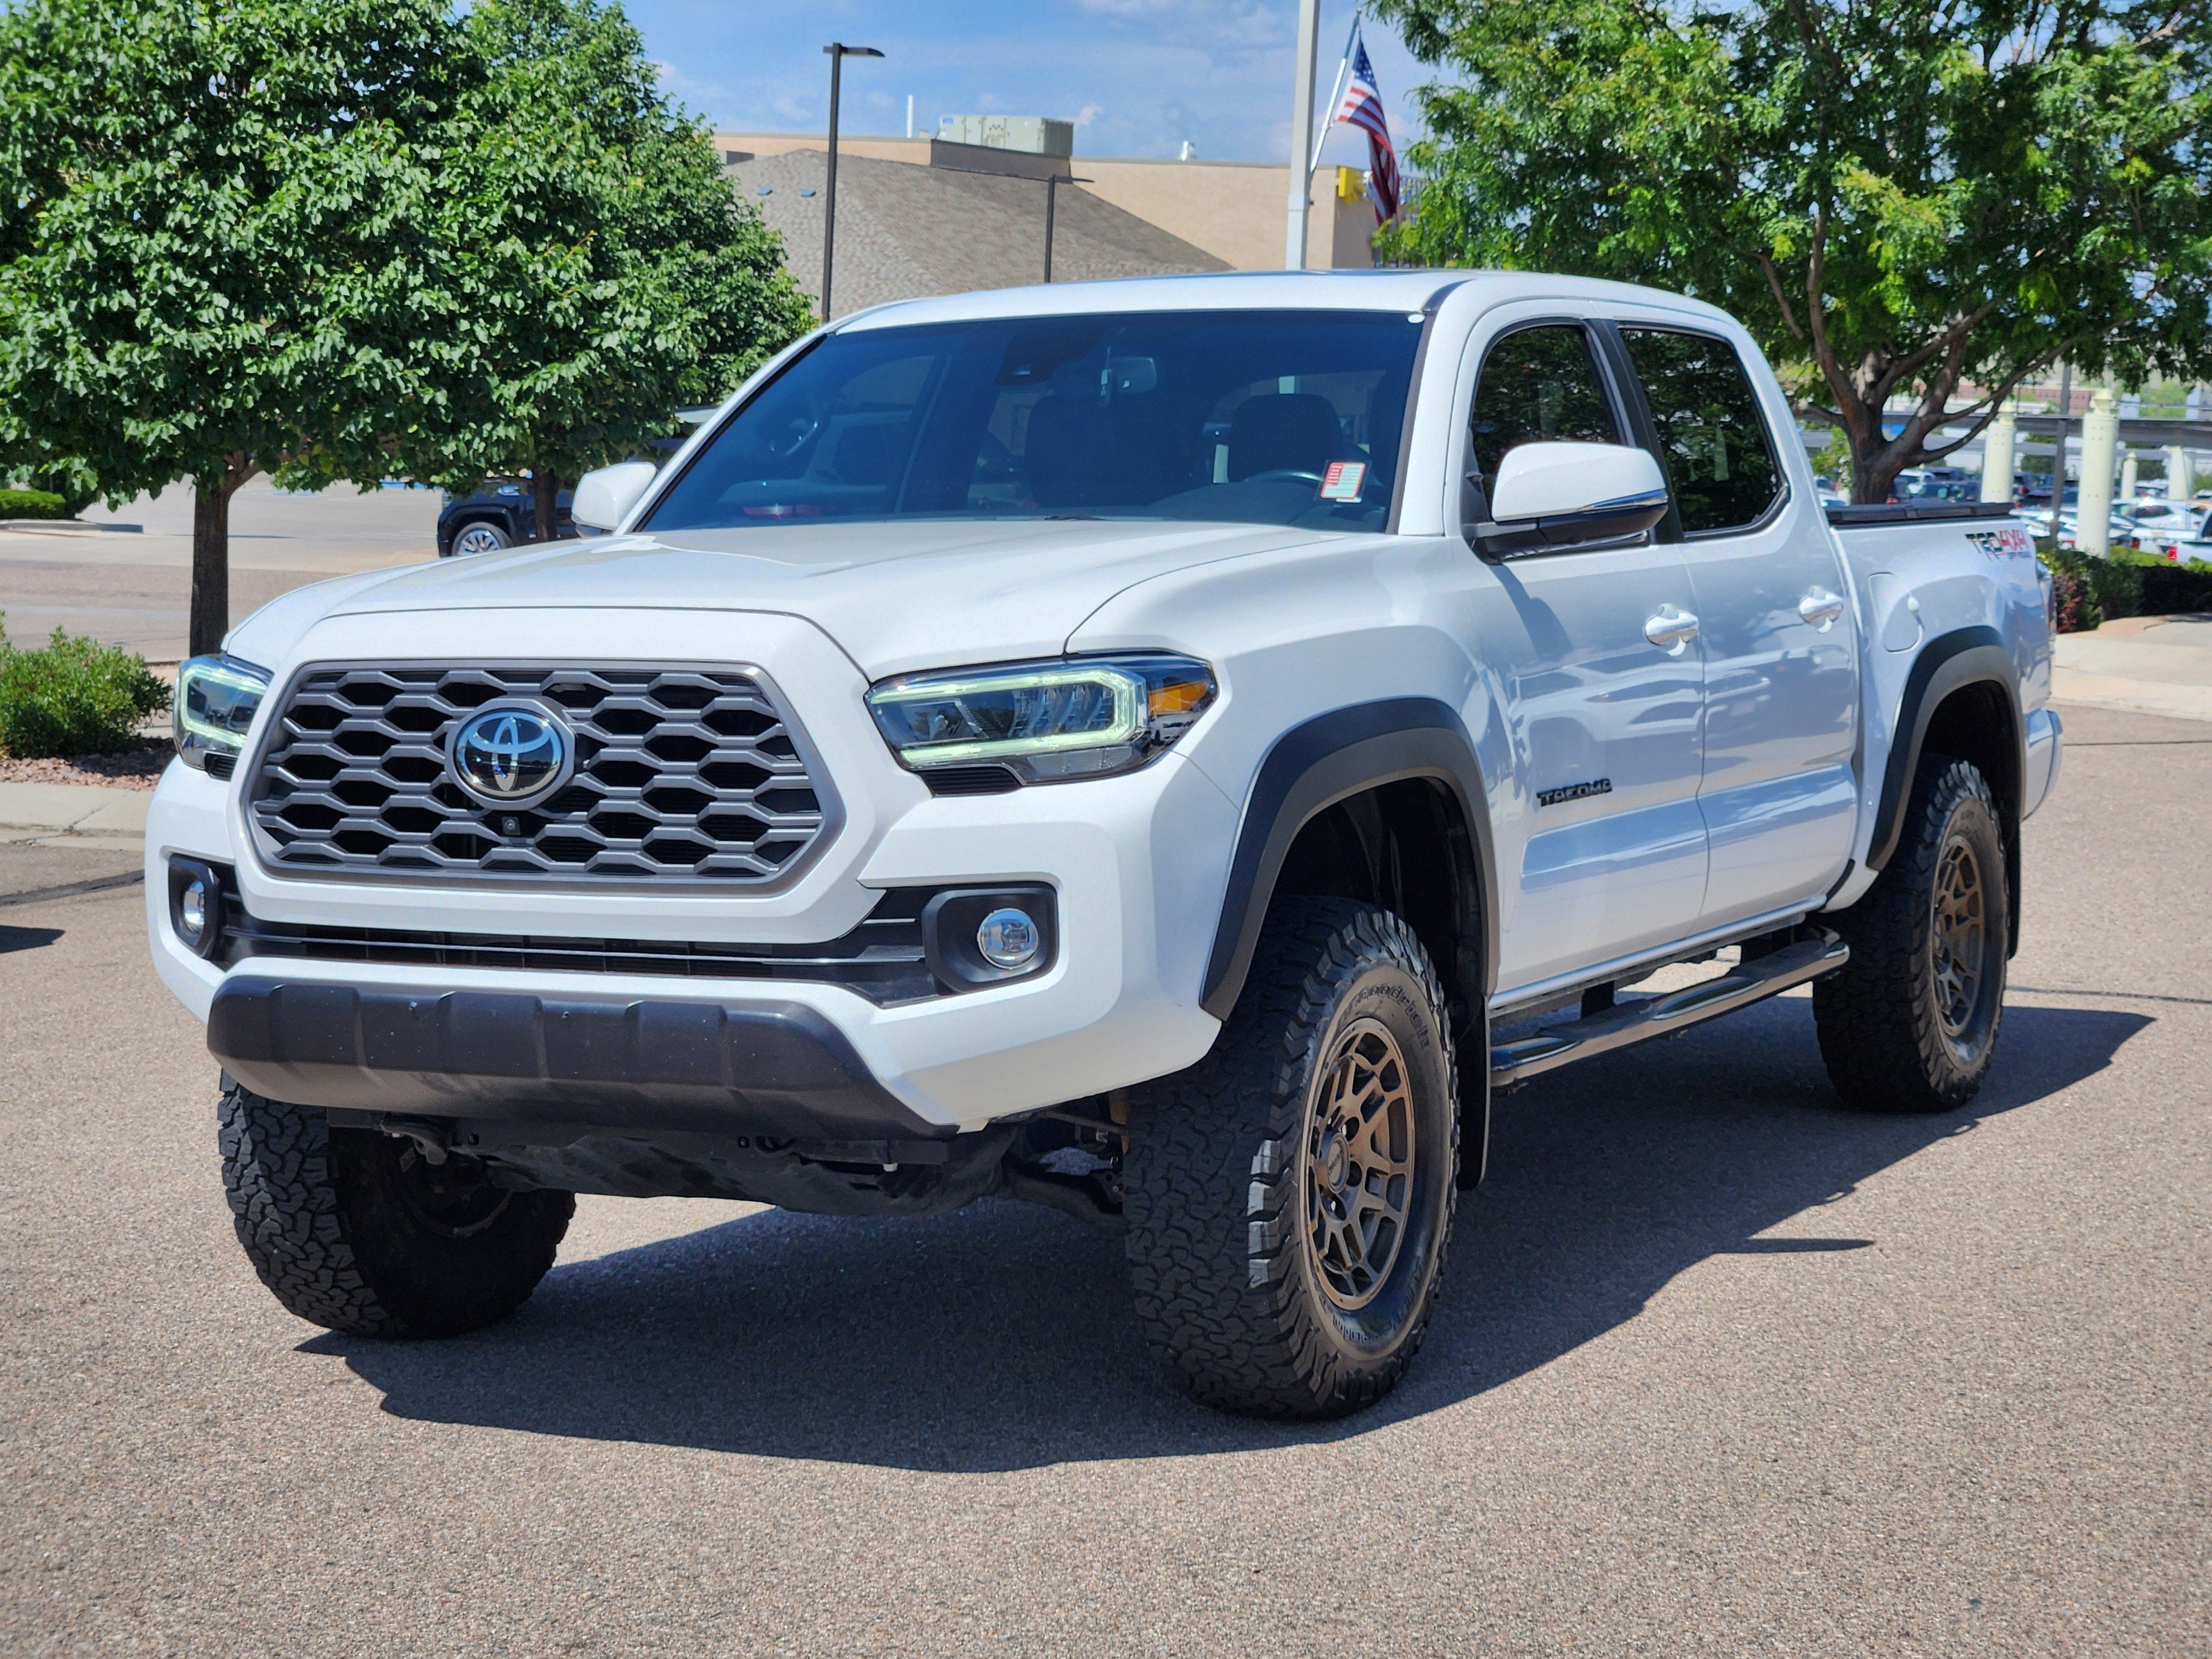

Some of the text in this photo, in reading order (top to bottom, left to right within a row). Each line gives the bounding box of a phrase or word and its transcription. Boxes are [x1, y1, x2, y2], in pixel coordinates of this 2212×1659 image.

[1965, 532, 2004, 563] TRD
[1536, 778, 1613, 807] TACOMA
[1339, 983, 1430, 1049] Goodrich
